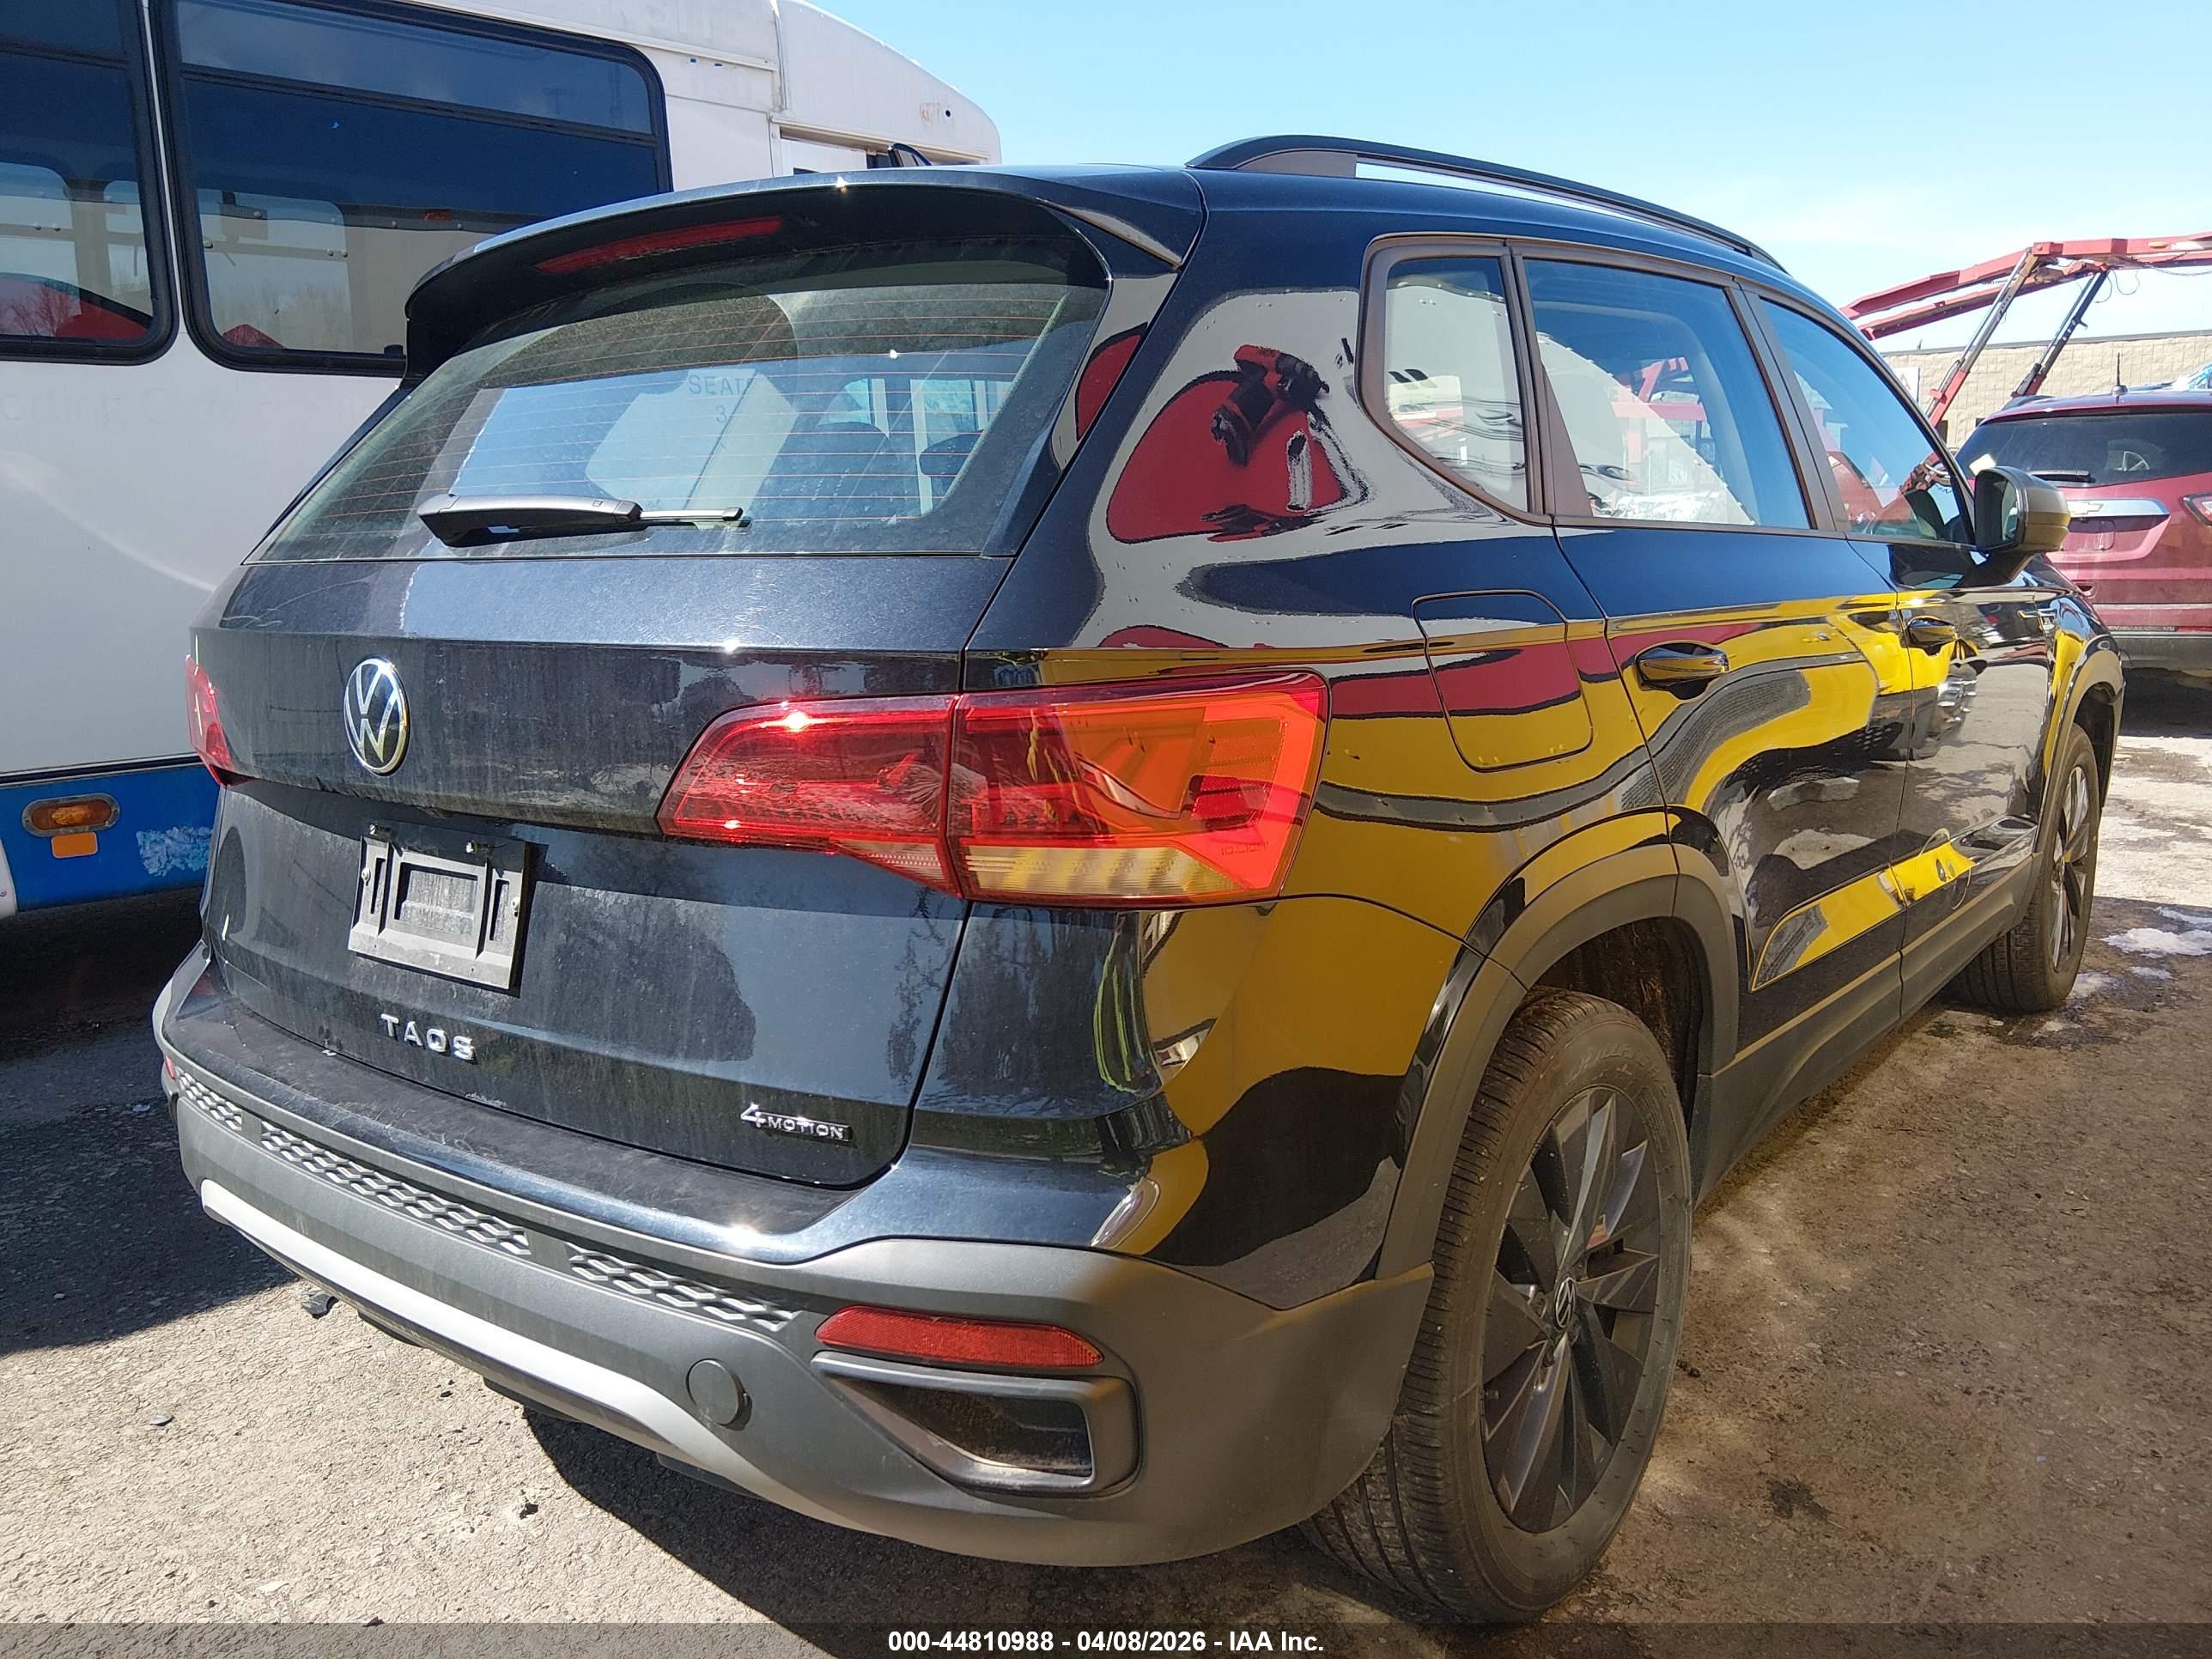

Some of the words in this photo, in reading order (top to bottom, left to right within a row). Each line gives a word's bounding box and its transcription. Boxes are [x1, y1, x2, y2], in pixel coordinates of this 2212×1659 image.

[688, 374, 753, 396] SEAT
[715, 404, 727, 423] 3
[380, 1012, 476, 1061] TAOS
[739, 1102, 844, 1139] 4MOTION
